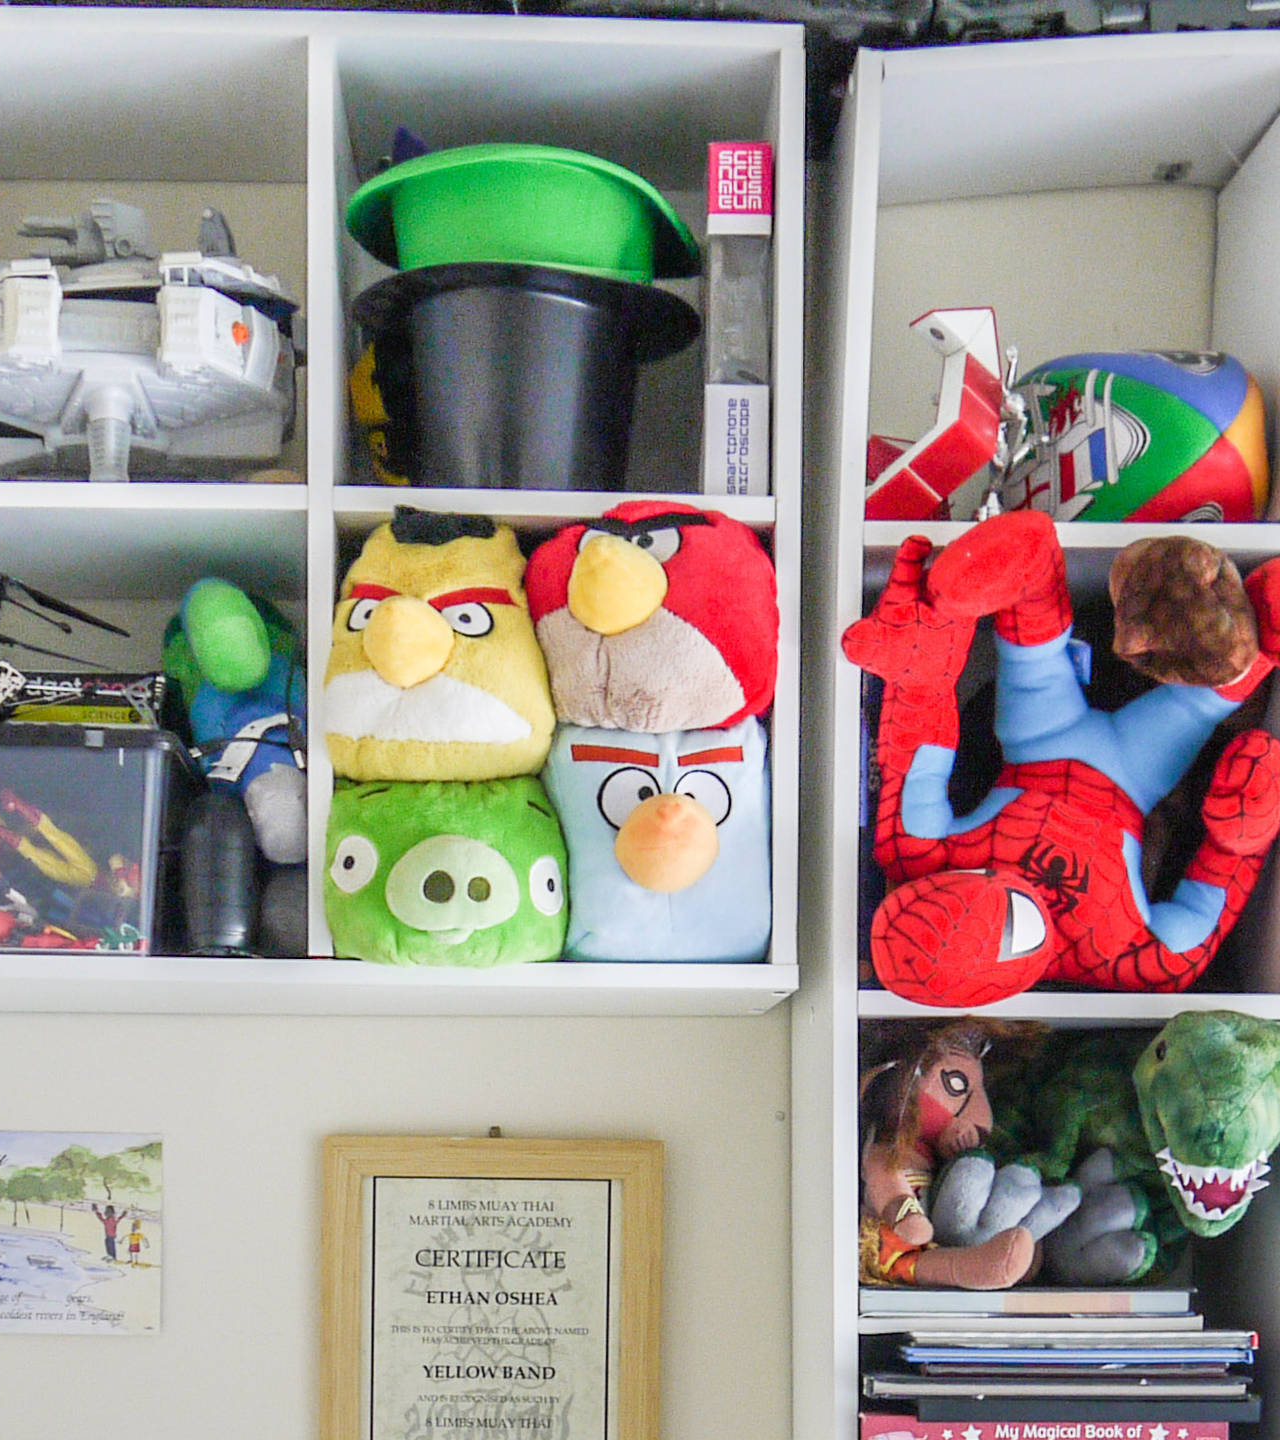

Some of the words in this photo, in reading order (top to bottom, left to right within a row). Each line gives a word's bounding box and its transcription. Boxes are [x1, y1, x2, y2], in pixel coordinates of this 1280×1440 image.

[726, 398, 737, 495] smartphone
[738, 398, 750, 495] microscope
[428, 1200, 436, 1210] 8
[438, 1200, 477, 1211] LIMBS
[480, 1201, 520, 1212] MUAY
[522, 1201, 555, 1212] THAI
[409, 1215, 467, 1226] MARTIAL
[470, 1216, 505, 1227] ARTS
[506, 1216, 573, 1228] ACADEMY
[415, 1249, 566, 1269] CERTIFICATE
[426, 1291, 491, 1305] ETHAN
[495, 1291, 558, 1305] OSHEA
[436, 1325, 472, 1335] CERTIFY
[475, 1326, 500, 1335] THAT
[502, 1326, 521, 1335] THE
[523, 1326, 552, 1335] ABOVE
[554, 1327, 589, 1336] NAMED
[422, 1365, 498, 1379] YELLOW
[502, 1366, 556, 1380] BAND
[425, 1418, 433, 1428] 8
[436, 1418, 475, 1428] LIMBS
[477, 1418, 518, 1429] MUAY
[520, 1418, 552, 1429] THAI
[994, 1424, 1019, 1440] My
[1022, 1424, 1081, 1440] Magical
[1085, 1425, 1123, 1440] Book
[1126, 1424, 1143, 1440] of
